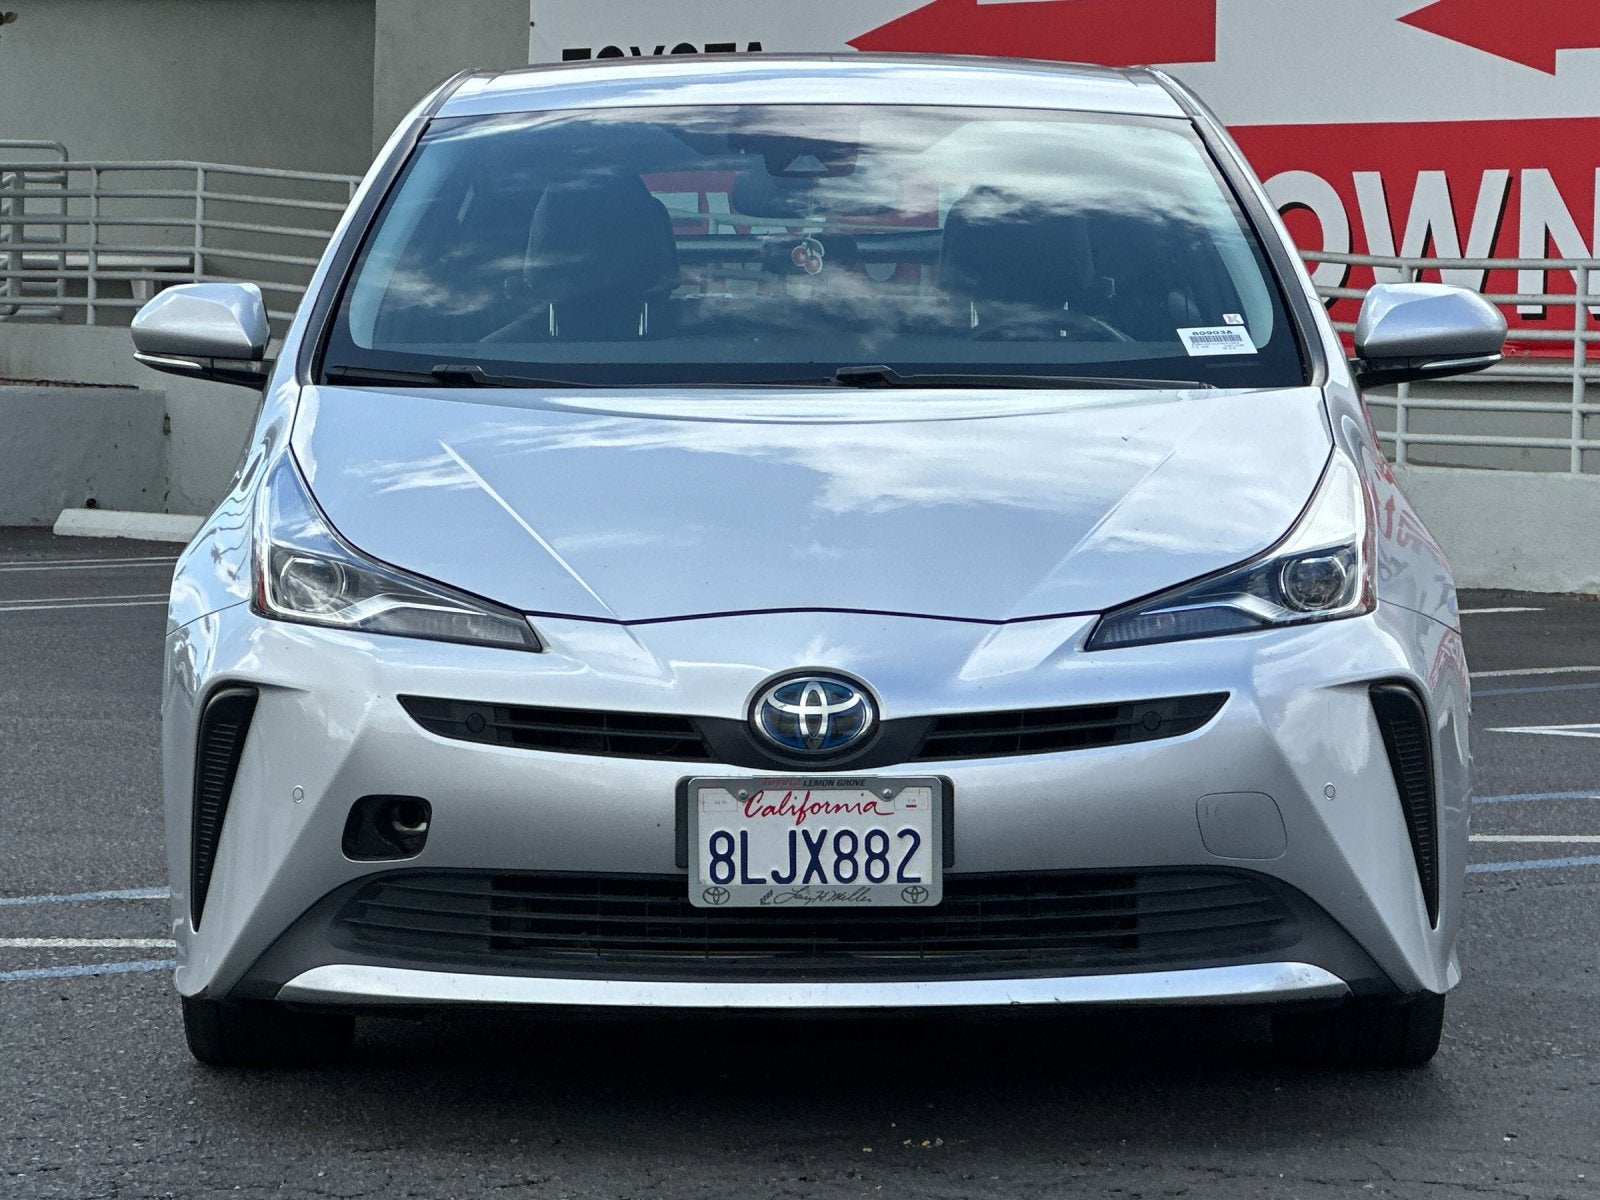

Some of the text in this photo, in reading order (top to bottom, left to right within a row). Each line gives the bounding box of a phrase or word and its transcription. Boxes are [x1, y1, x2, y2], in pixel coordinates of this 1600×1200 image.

[803, 779, 834, 787] LEMON
[836, 778, 866, 787] GROVE
[744, 789, 895, 826] California
[709, 828, 922, 885] 8LJX882
